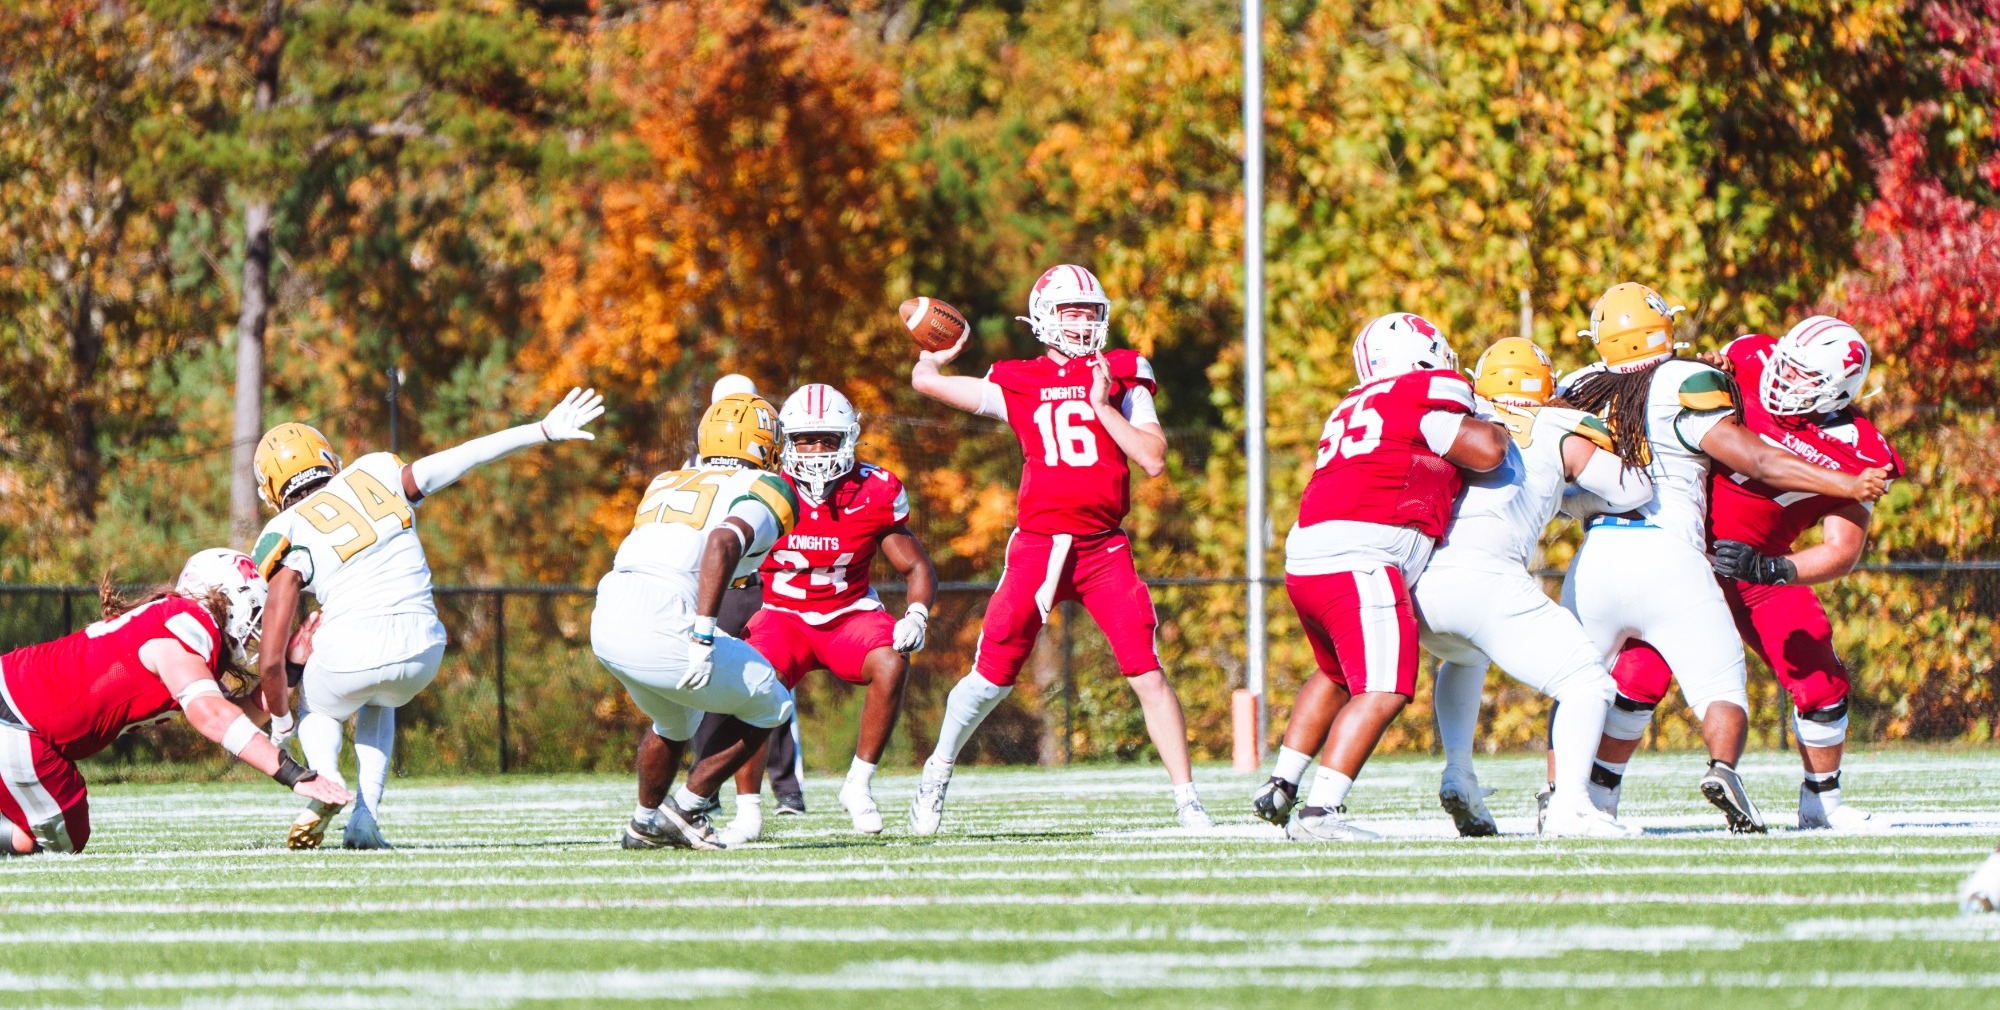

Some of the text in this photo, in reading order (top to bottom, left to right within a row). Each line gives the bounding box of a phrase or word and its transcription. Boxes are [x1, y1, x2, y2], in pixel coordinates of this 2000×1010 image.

[929, 317, 955, 338] Wilson
[1620, 358, 1660, 374] Riddell
[1040, 385, 1086, 401] KNIGHTS
[1033, 400, 1099, 467] 16
[1315, 380, 1397, 470] 55
[1781, 432, 1841, 471] KNIGHTS
[294, 468, 413, 563] 94
[634, 468, 739, 531] 25
[787, 534, 840, 551] KNIGHTS
[771, 549, 855, 600] 24
